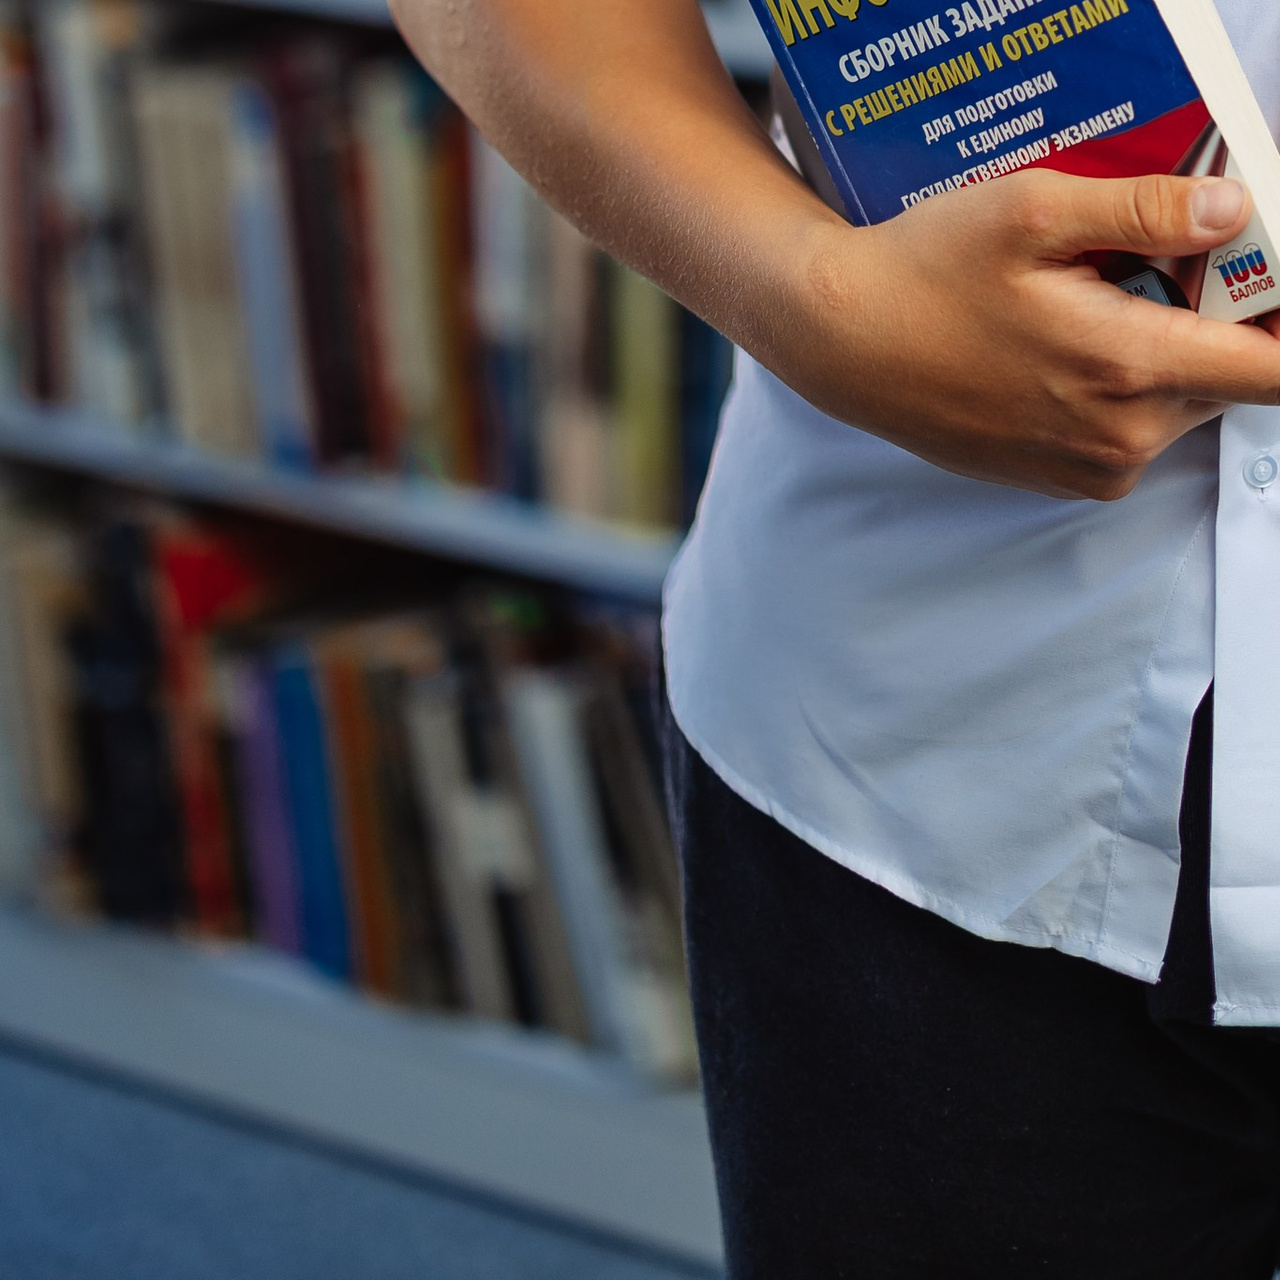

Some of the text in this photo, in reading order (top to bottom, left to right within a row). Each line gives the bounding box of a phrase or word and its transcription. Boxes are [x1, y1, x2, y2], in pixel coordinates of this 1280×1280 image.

[839, 13, 950, 83] СБОРНИК
[825, 110, 844, 136] С
[839, 51, 981, 132] РЕШЕНИЯМИ
[978, 42, 1003, 72] И
[921, 70, 1058, 145] ДЛЯ ПОДГОТОВКИ
[956, 107, 1045, 159] К ЕДИНОМУ
[1053, 100, 1135, 152] ЭКЗАМЕНУ
[1212, 242, 1268, 288] 100
[1229, 275, 1275, 303] БАЛЛОВ
